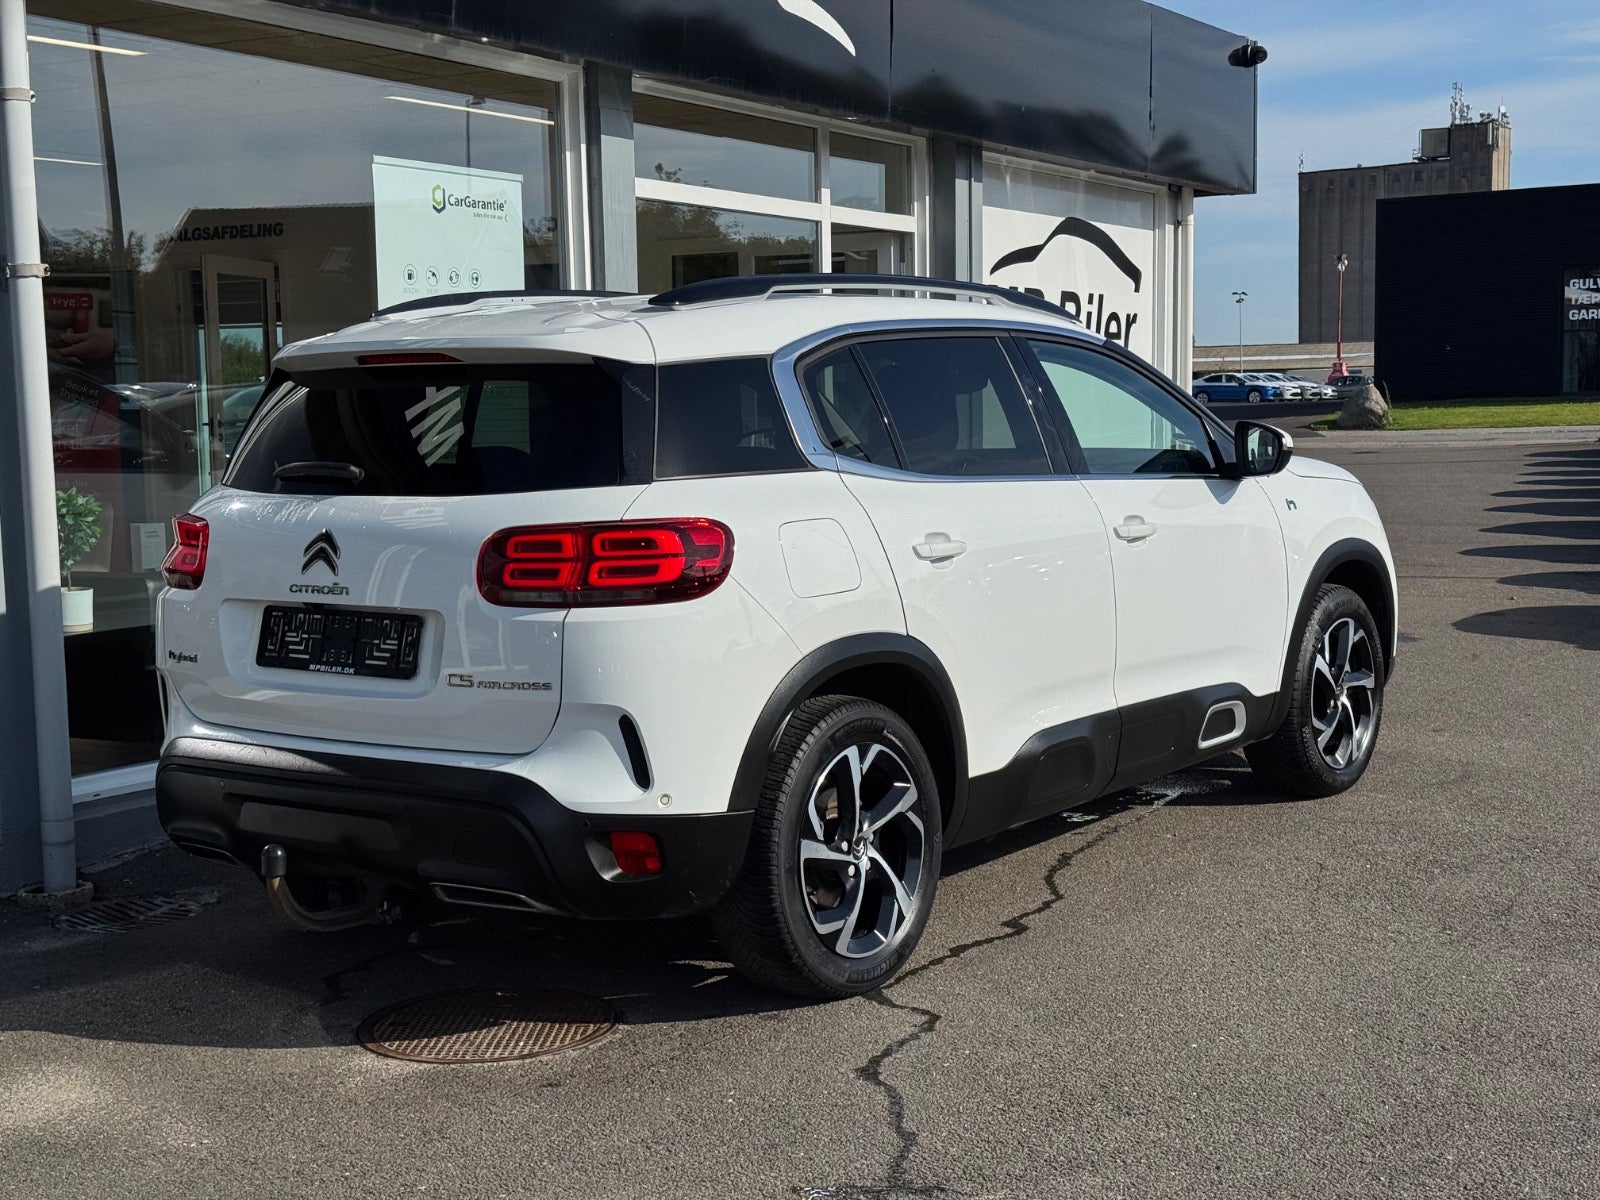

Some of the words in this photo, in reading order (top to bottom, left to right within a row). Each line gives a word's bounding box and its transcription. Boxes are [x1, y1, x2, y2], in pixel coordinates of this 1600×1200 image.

[169, 222, 284, 242] ALGSAFDELING
[1569, 309, 1600, 320] GAR
[446, 673, 475, 688] C5
[476, 680, 553, 691] AIRCROSS
